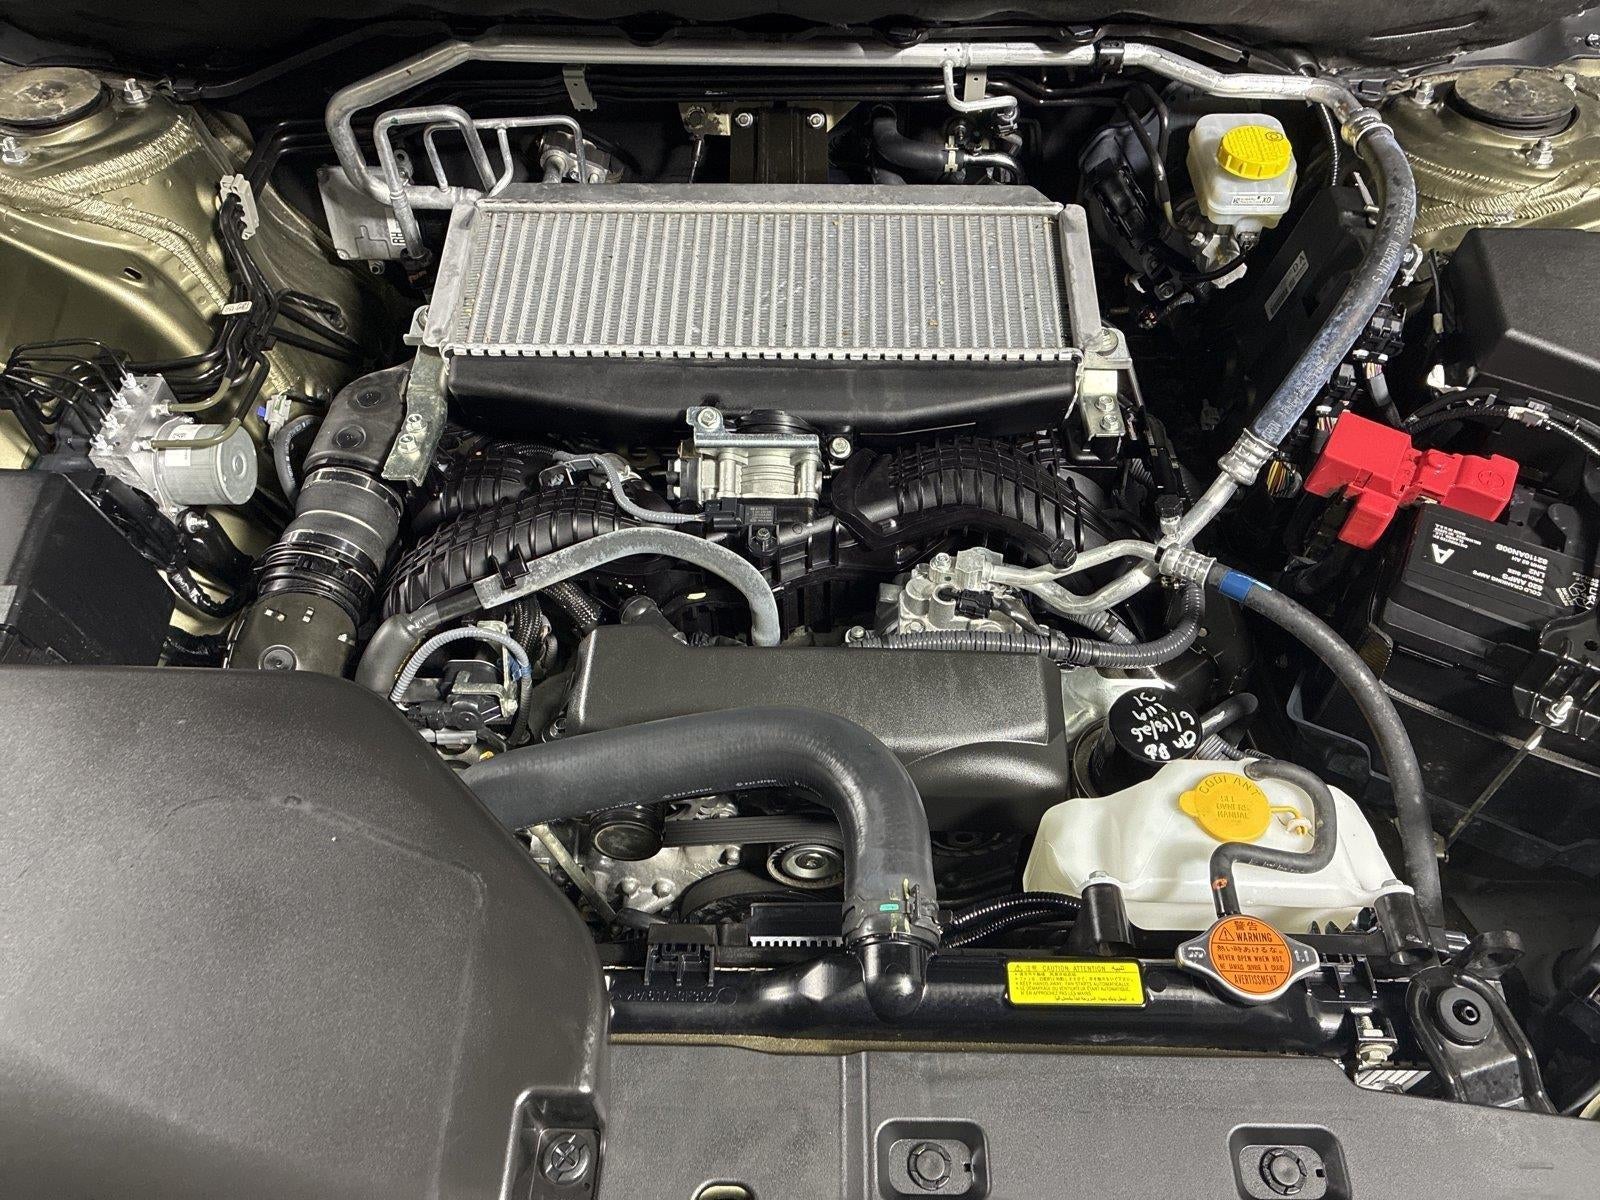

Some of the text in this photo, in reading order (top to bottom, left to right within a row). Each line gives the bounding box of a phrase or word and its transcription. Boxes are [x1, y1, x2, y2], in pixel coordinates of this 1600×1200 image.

[1521, 572, 1544, 583] GROUP
[1527, 567, 1546, 578] LN2
[1471, 569, 1542, 596] COLD CRANKING AMPS
[1501, 572, 1527, 585] AMPS
[1234, 920, 1258, 931] 警告
[1236, 932, 1272, 942] WARNING
[1218, 954, 1236, 962] NEVER
[1042, 965, 1069, 973] CAUTION
[1073, 965, 1106, 973] ATTENTION
